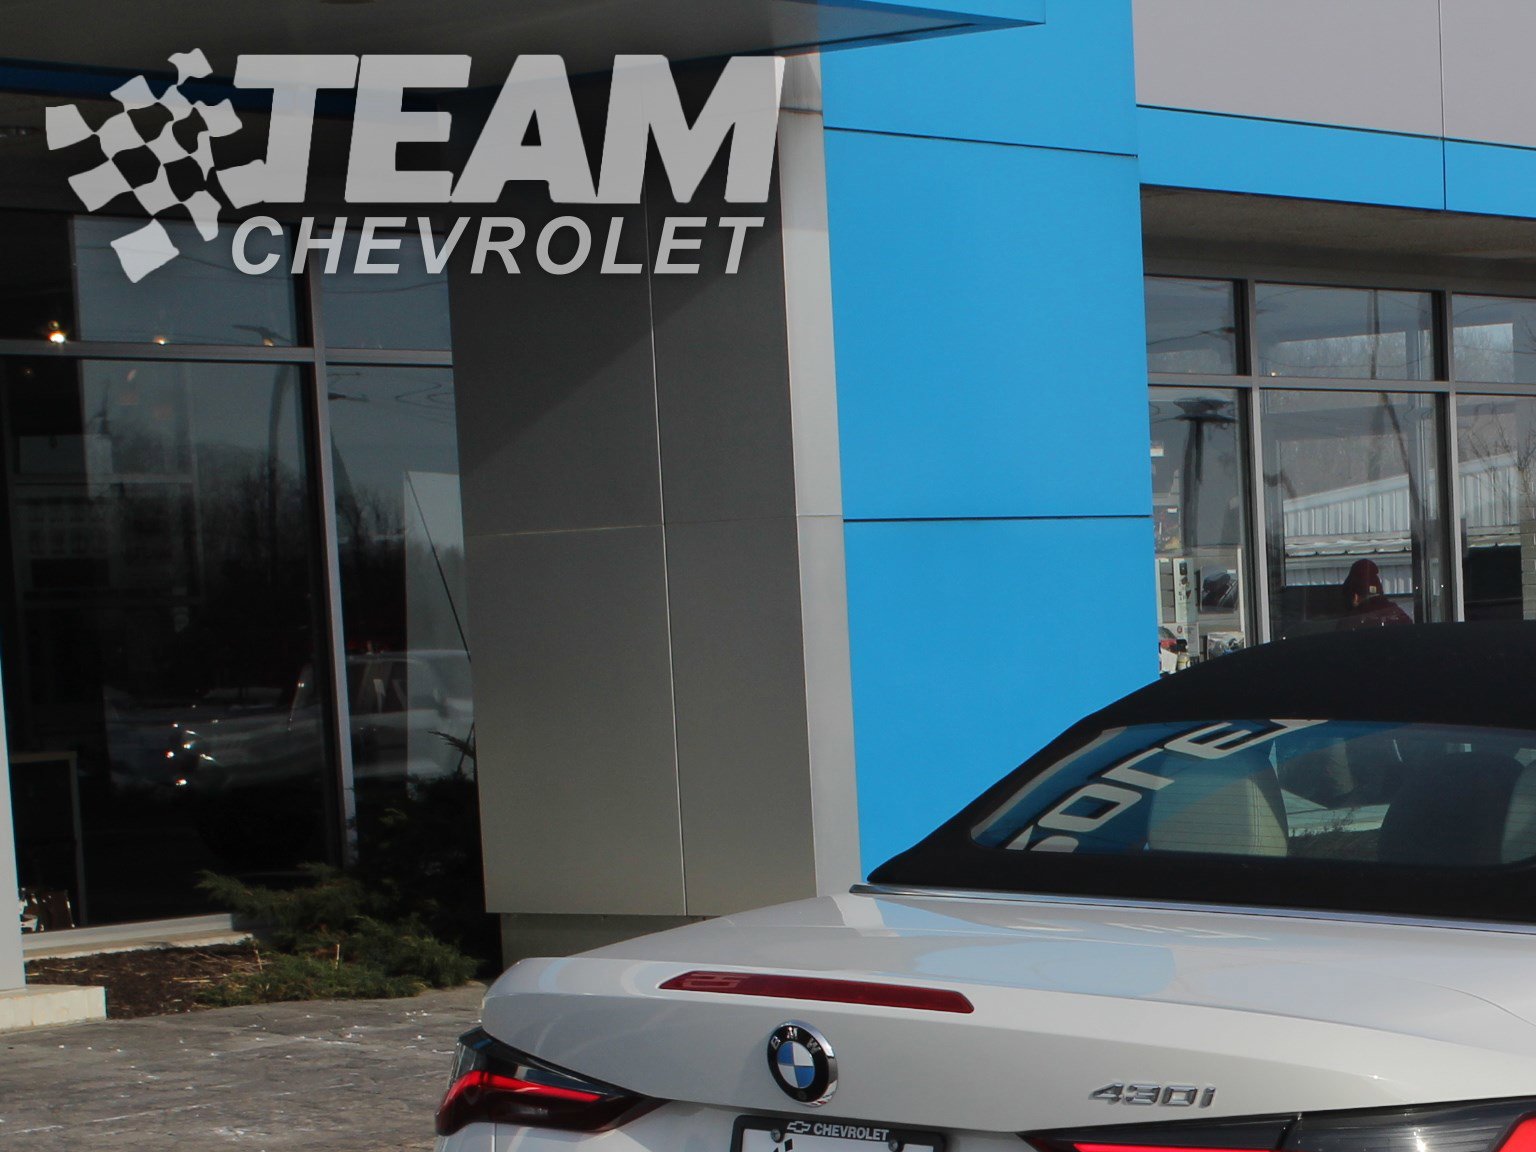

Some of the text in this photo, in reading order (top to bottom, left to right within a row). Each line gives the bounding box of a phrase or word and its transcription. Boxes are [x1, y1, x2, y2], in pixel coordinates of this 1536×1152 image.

[771, 1027, 821, 1054] BMW
[1088, 1082, 1216, 1108] 430i
[813, 1122, 889, 1141] CHEVROLET
